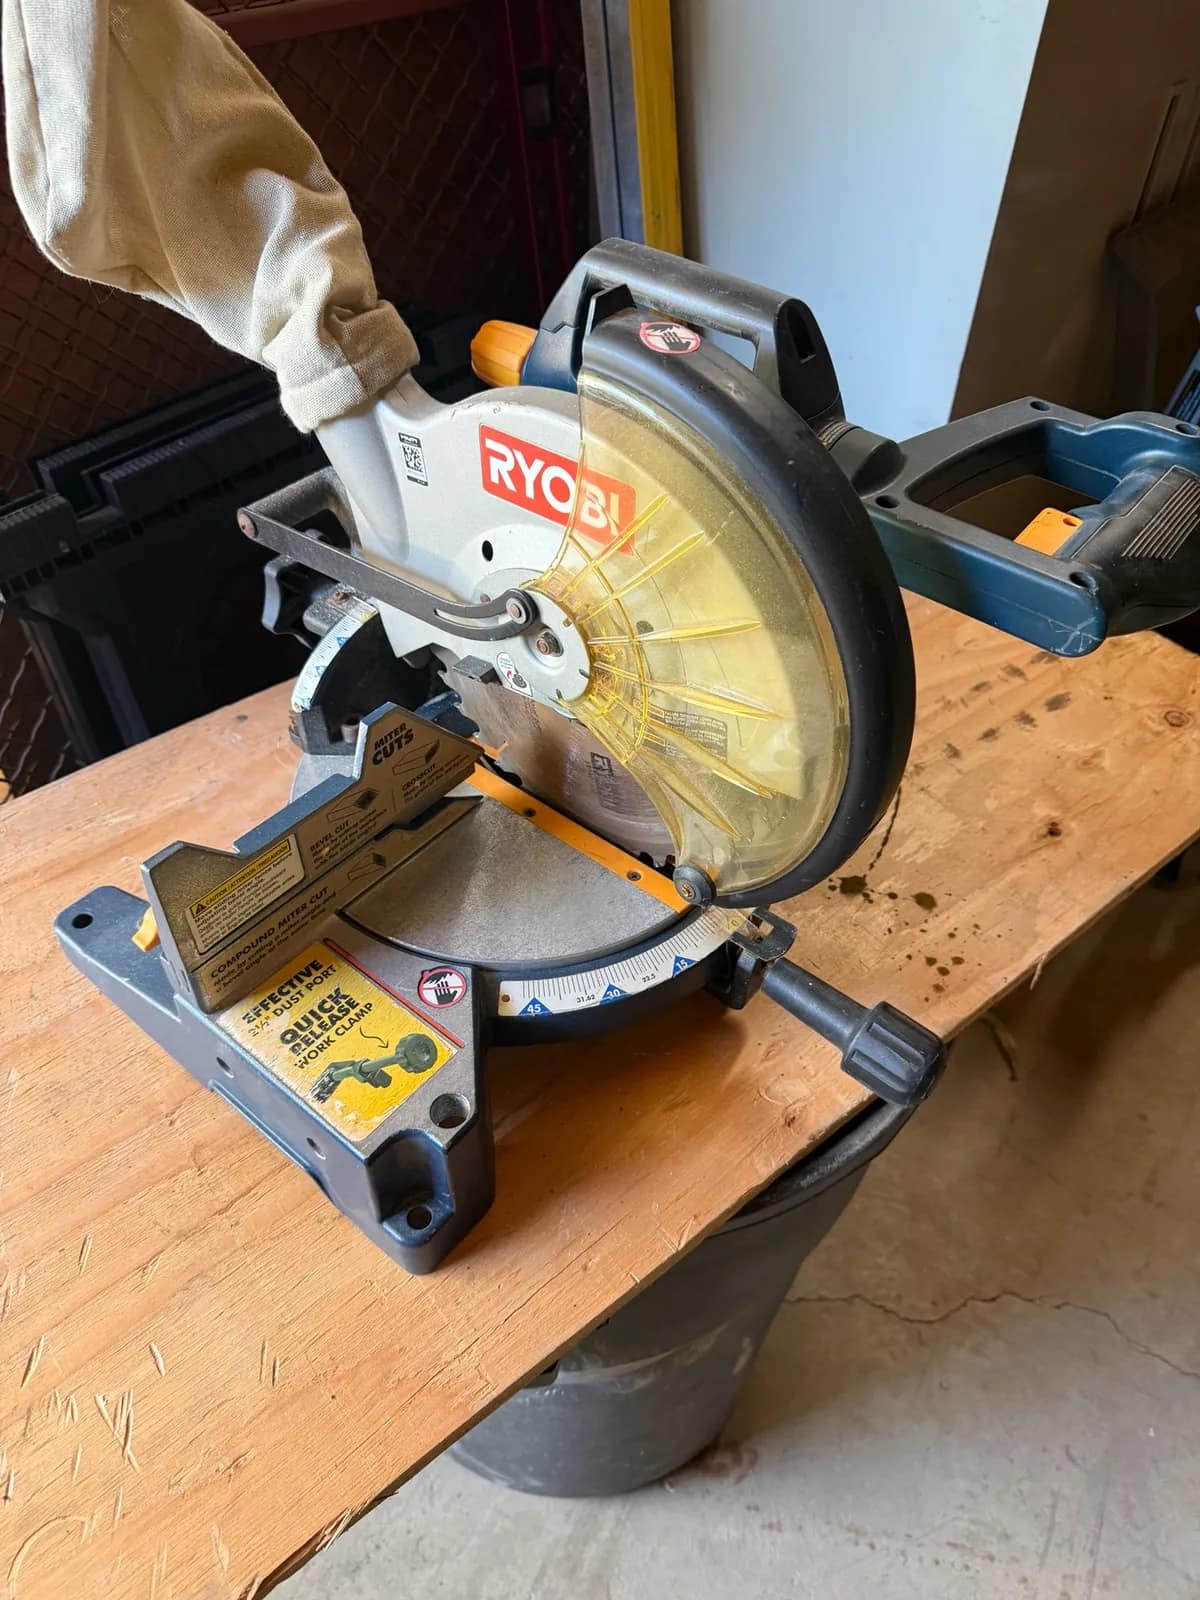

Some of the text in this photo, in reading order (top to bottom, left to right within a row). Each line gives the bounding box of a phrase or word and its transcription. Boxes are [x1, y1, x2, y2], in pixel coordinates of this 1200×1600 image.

[484, 438, 620, 537] RYOBI
[372, 728, 414, 765] CUTS
[374, 723, 407, 750] MITER
[310, 831, 332, 851] BEVEL
[334, 819, 349, 834] CUT
[205, 886, 227, 906] CAUTION
[211, 927, 275, 978] COMPOUND
[278, 902, 307, 928] MITER
[310, 887, 328, 904] CUT
[242, 959, 323, 1024] EFFECTIVE
[272, 990, 306, 1017] DUST
[307, 965, 337, 991] PORT
[279, 986, 350, 1045] QUICK
[527, 1003, 541, 1015] 45
[576, 994, 596, 1003] 31.62
[606, 989, 620, 999] 30
[642, 973, 656, 982] 22.5
[675, 960, 688, 970] 15
[288, 997, 360, 1056] RELEASE
[294, 1002, 373, 1069] WORK CLAMP
